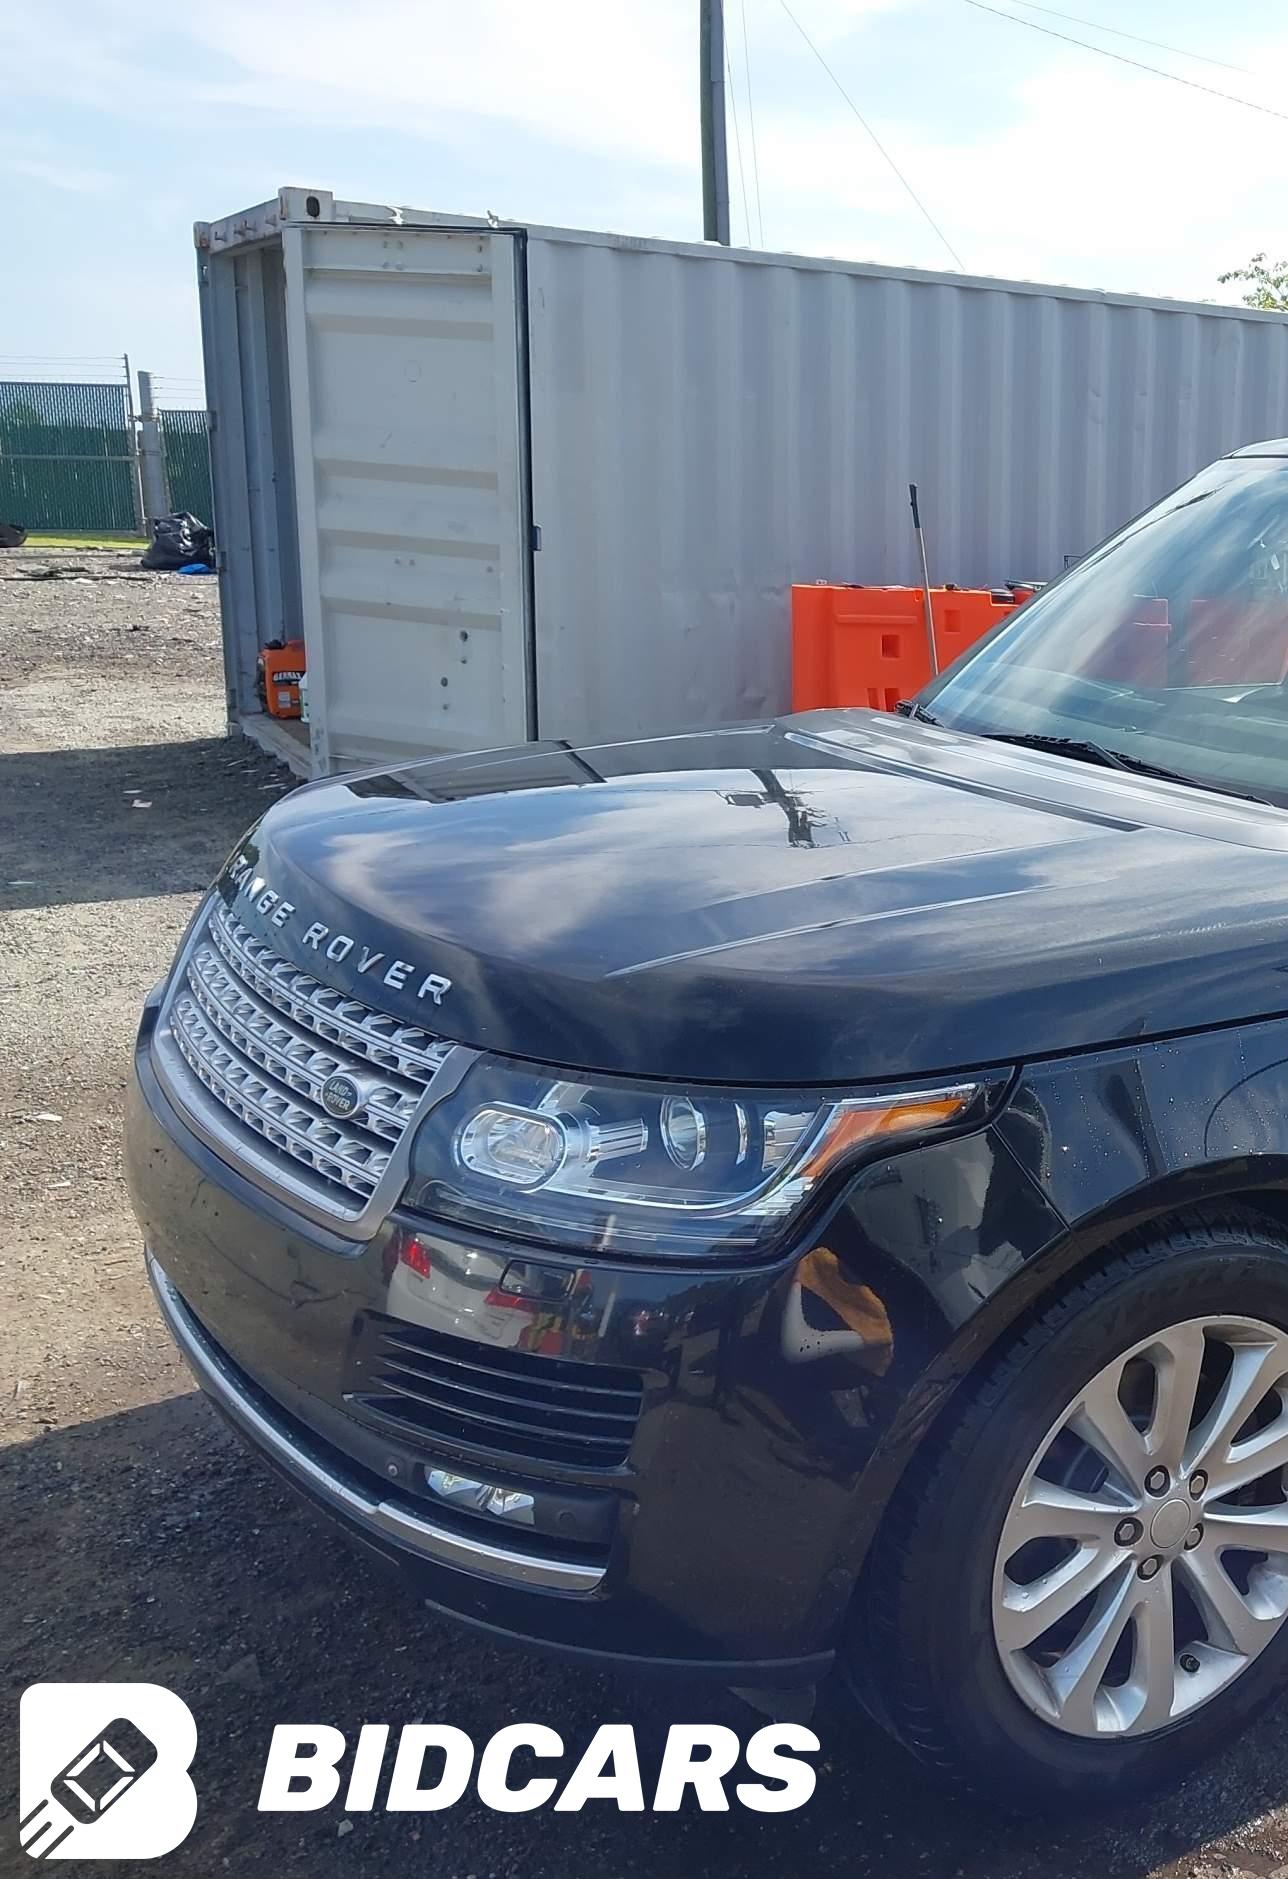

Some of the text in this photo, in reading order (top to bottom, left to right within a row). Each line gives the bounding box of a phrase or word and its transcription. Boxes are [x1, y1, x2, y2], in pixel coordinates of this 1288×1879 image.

[228, 854, 452, 1006] RANGE ROVER
[328, 1080, 350, 1097] LAND
[326, 1092, 351, 1111] ROVER
